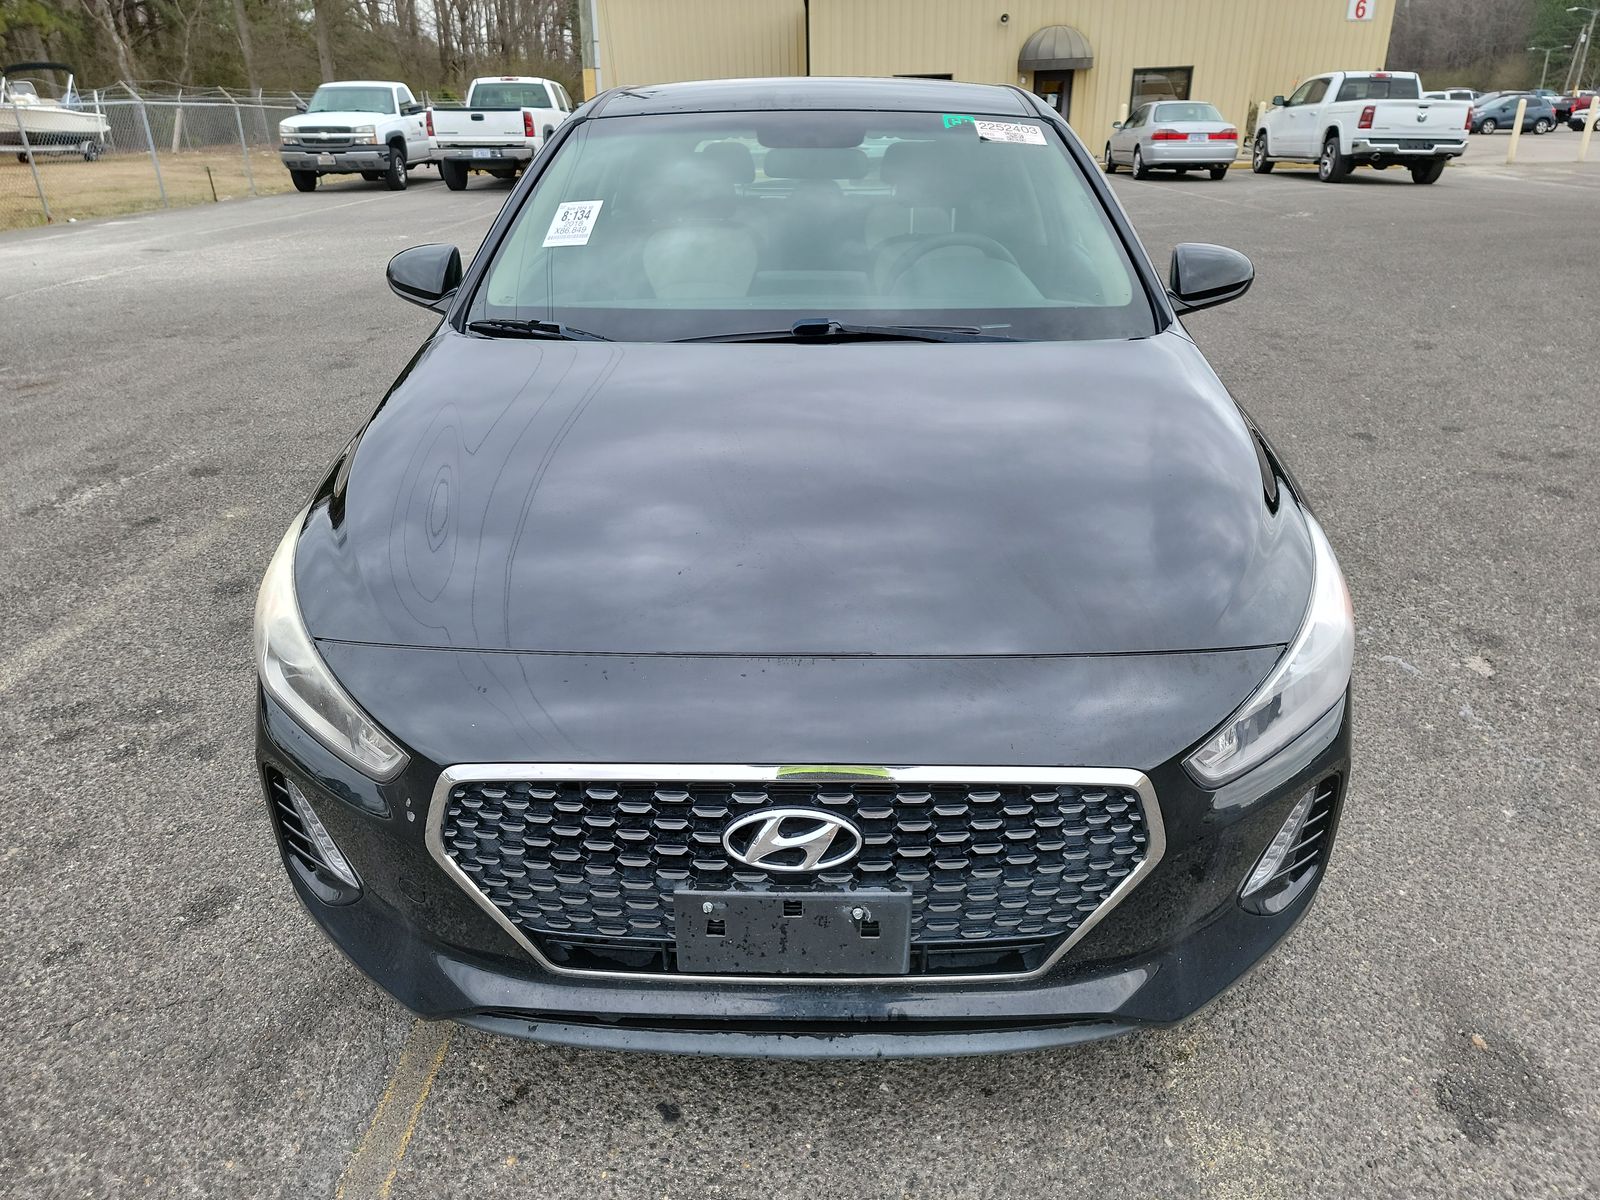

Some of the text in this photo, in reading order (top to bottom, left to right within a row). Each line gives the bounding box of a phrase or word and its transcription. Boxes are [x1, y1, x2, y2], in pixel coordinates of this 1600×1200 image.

[1355, 0, 1367, 19] 6
[979, 122, 1038, 134] 2252403
[561, 209, 591, 221] 8:134
